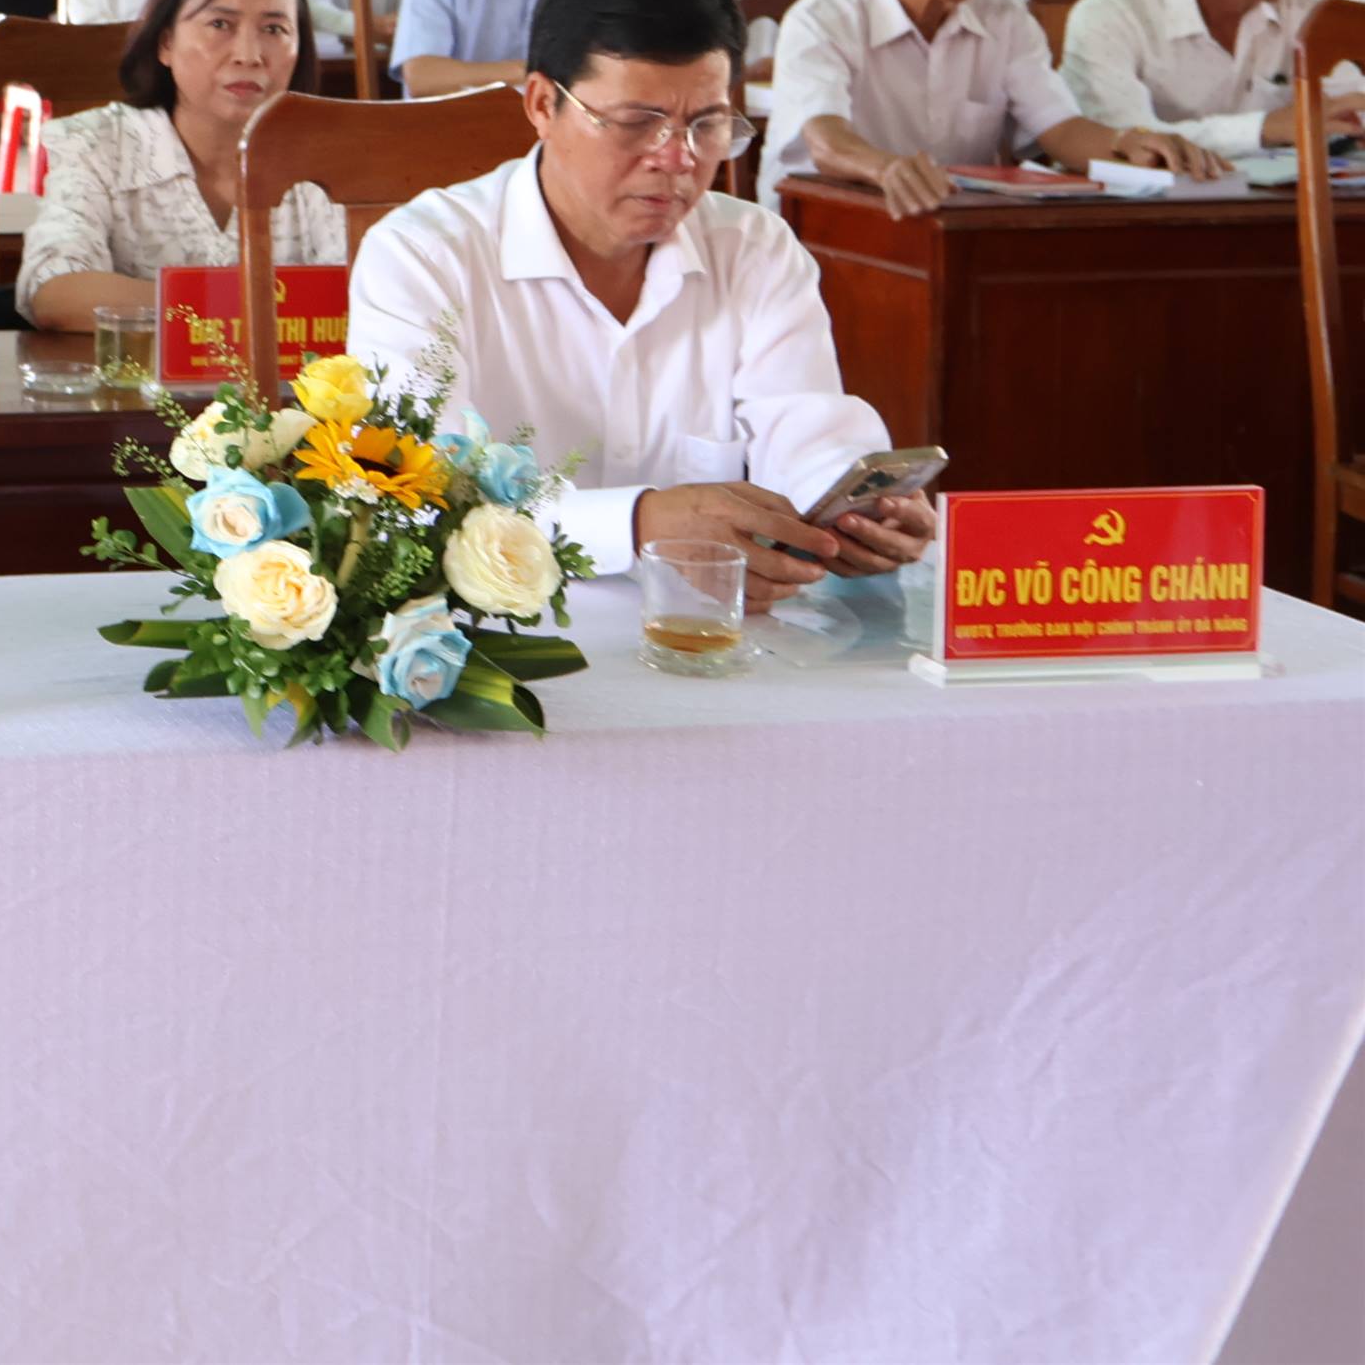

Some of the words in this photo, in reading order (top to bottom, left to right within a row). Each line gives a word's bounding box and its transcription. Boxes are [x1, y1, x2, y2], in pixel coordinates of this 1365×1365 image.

[956, 568, 1007, 606] Đ/C
[1014, 561, 1053, 605] VÕ
[1060, 559, 1142, 604] CÔNG
[1150, 556, 1249, 603] CHÁNH
